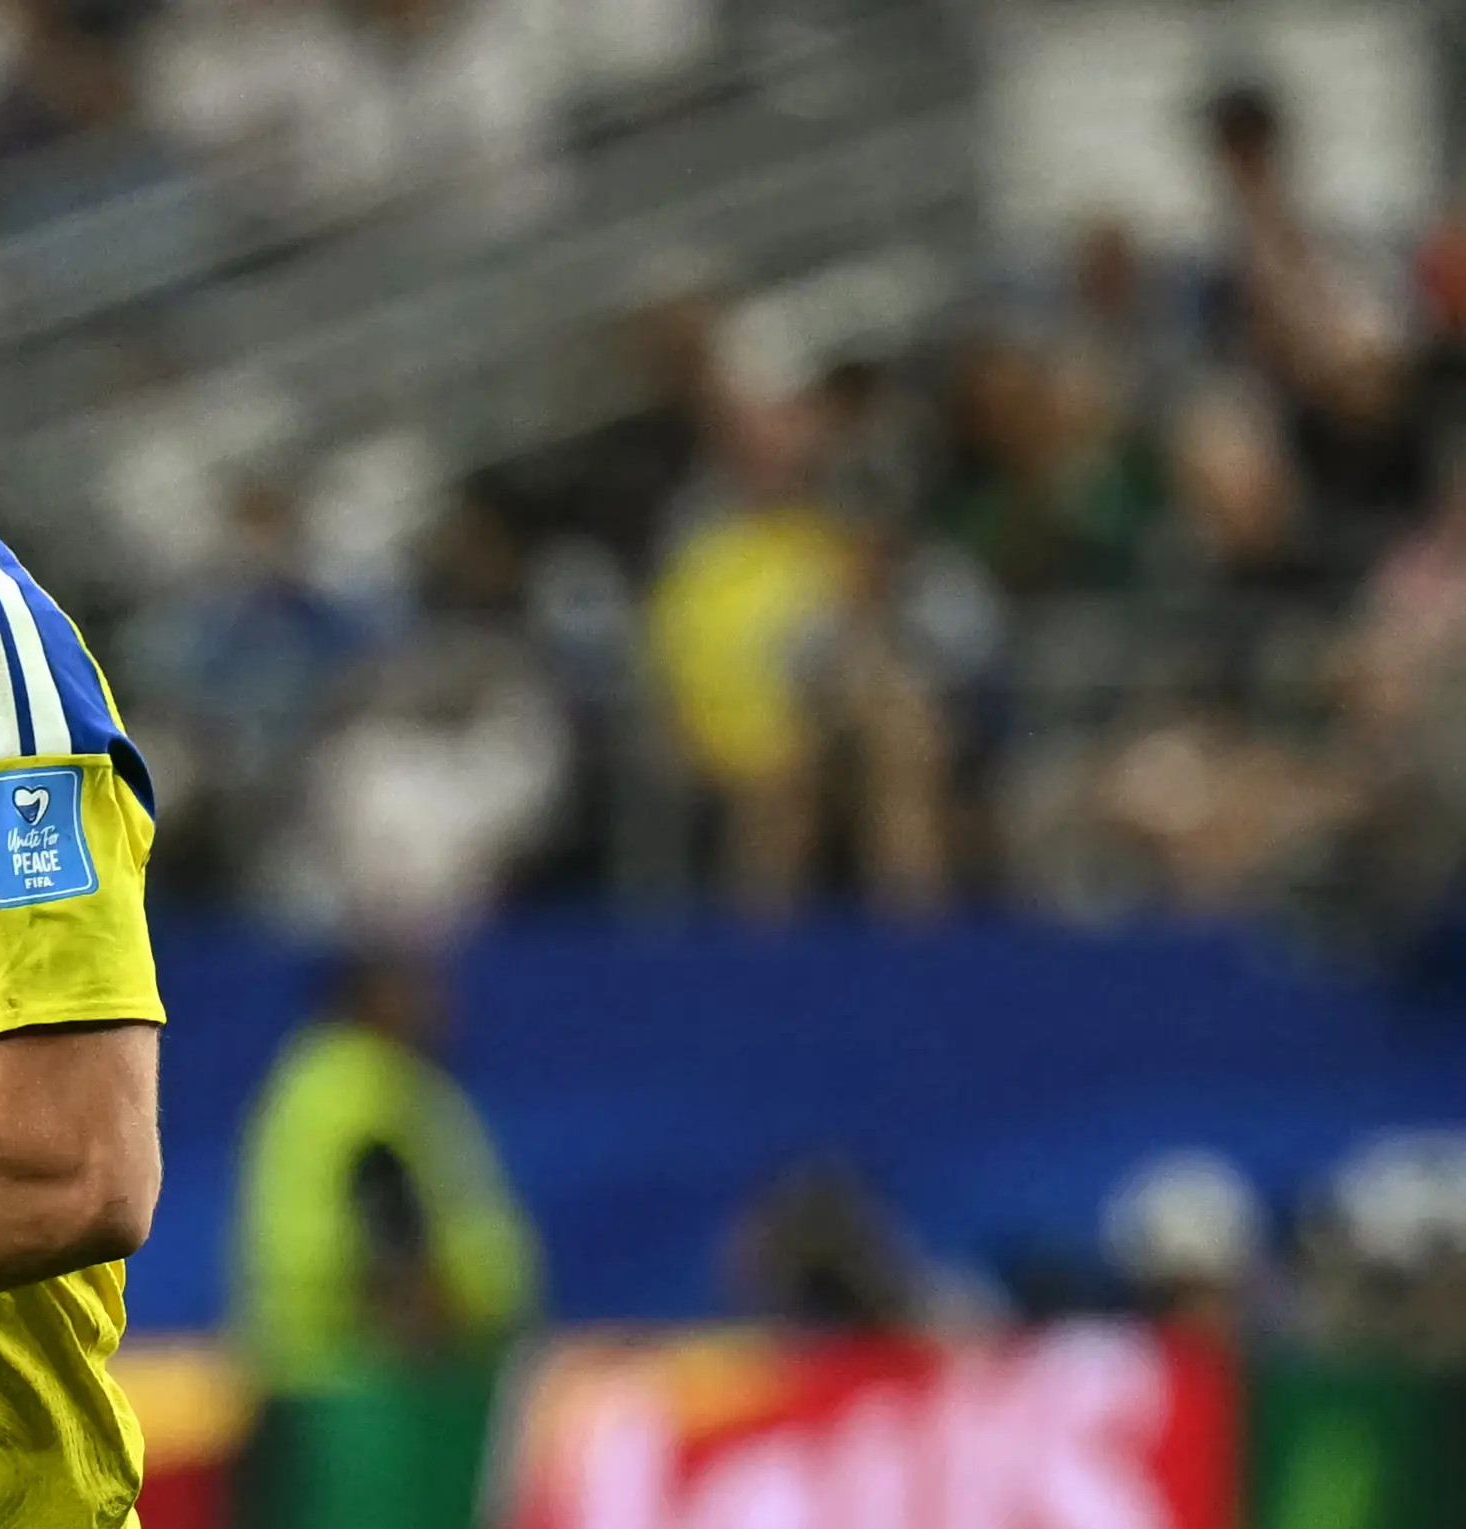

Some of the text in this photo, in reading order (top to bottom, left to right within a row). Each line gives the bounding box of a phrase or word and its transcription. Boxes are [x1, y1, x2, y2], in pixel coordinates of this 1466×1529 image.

[7, 828, 41, 853] Unite
[12, 849, 62, 876] PEACE
[24, 876, 55, 890] FIFA
